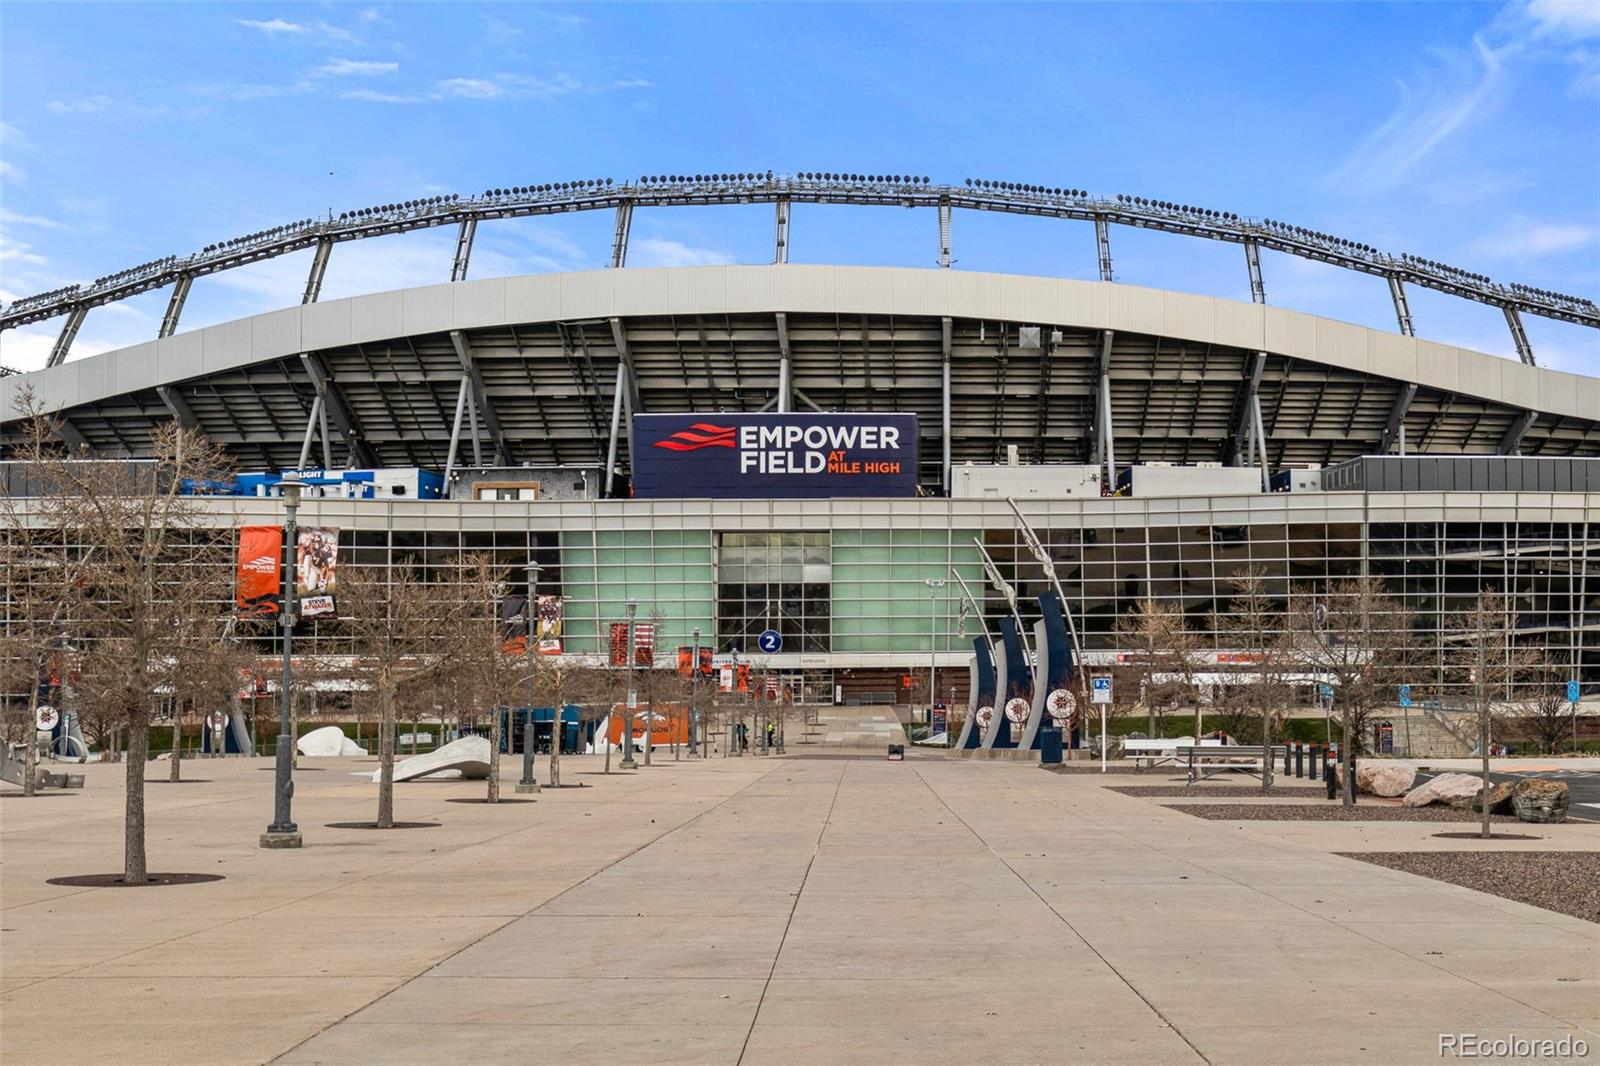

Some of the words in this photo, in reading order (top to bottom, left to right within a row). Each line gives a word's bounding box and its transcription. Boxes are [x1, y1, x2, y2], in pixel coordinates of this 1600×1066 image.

[740, 426, 900, 449] EMPOWER
[740, 451, 826, 474] FIELD
[829, 451, 846, 462] AT
[829, 463, 861, 473] MILE
[865, 463, 900, 473] HIGH
[765, 635, 776, 649] 2
